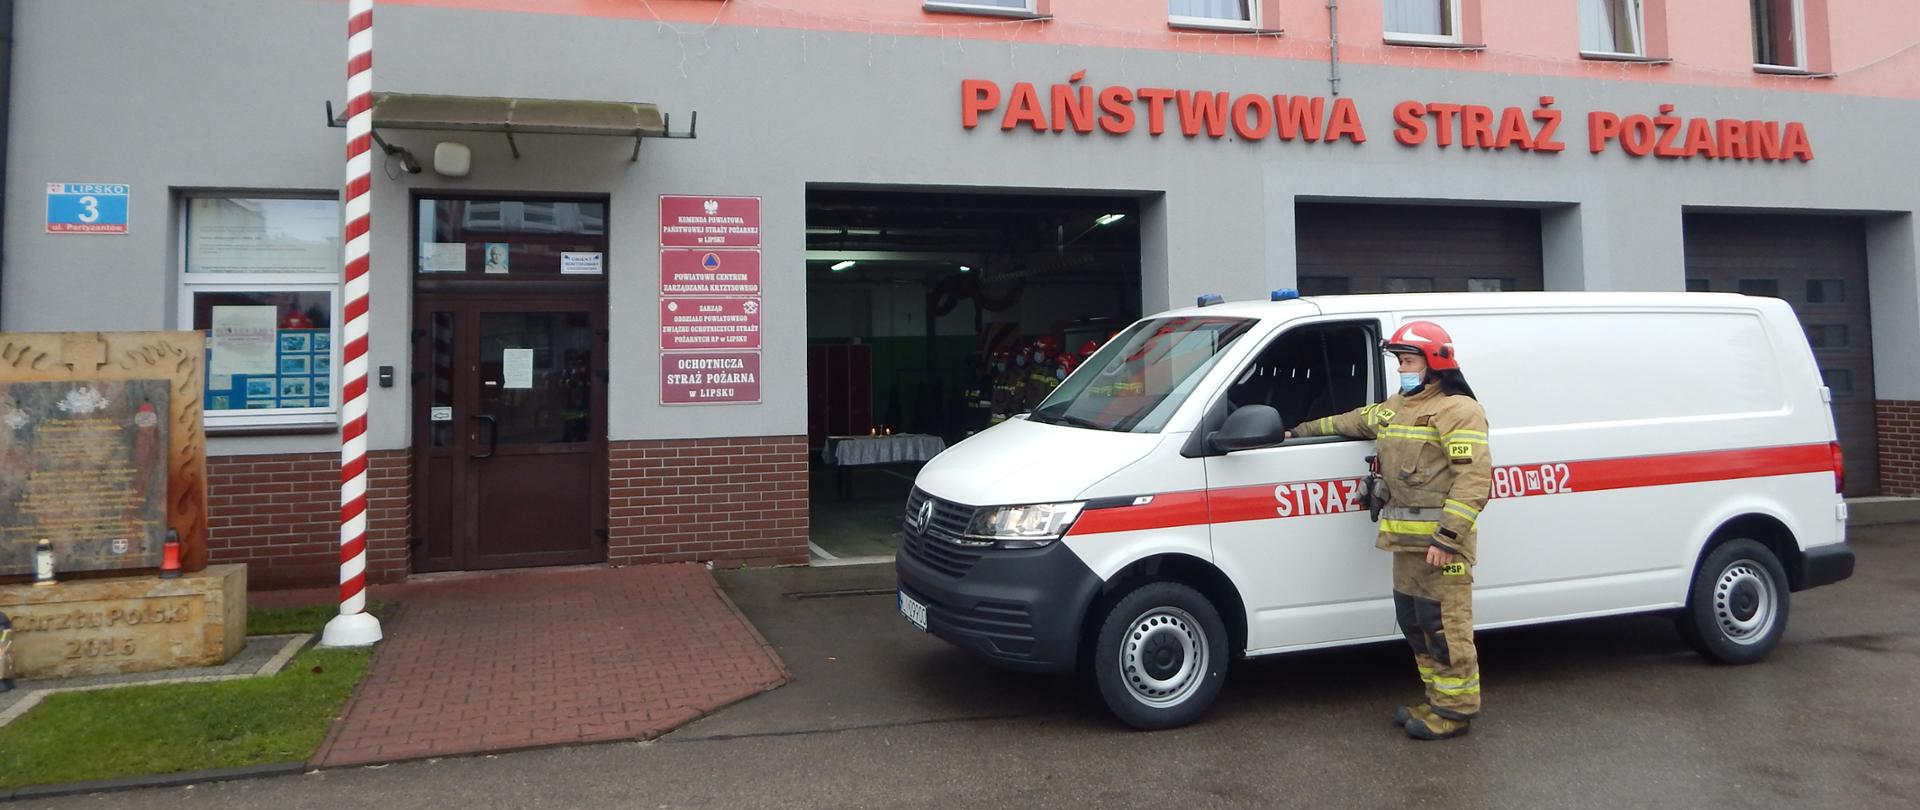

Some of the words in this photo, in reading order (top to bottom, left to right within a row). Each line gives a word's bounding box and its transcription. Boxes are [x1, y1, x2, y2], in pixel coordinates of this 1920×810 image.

[960, 68, 1367, 144] PAŃSTWOWA
[1392, 95, 1566, 153] STRAŻ
[1587, 103, 1815, 162] POŻARNA
[71, 183, 124, 194] LIPSKO
[78, 195, 99, 223] 3
[716, 273, 748, 281] CENTRUM
[678, 358, 744, 370] OCHOTNICZA
[667, 371, 703, 385] STRAŻ
[706, 371, 755, 384] POŻARNA
[688, 390, 697, 398] w
[700, 388, 735, 398] LIPSKU
[1451, 445, 1470, 455] PSP
[1445, 562, 1463, 574] PSP
[107, 601, 191, 628] Polski
